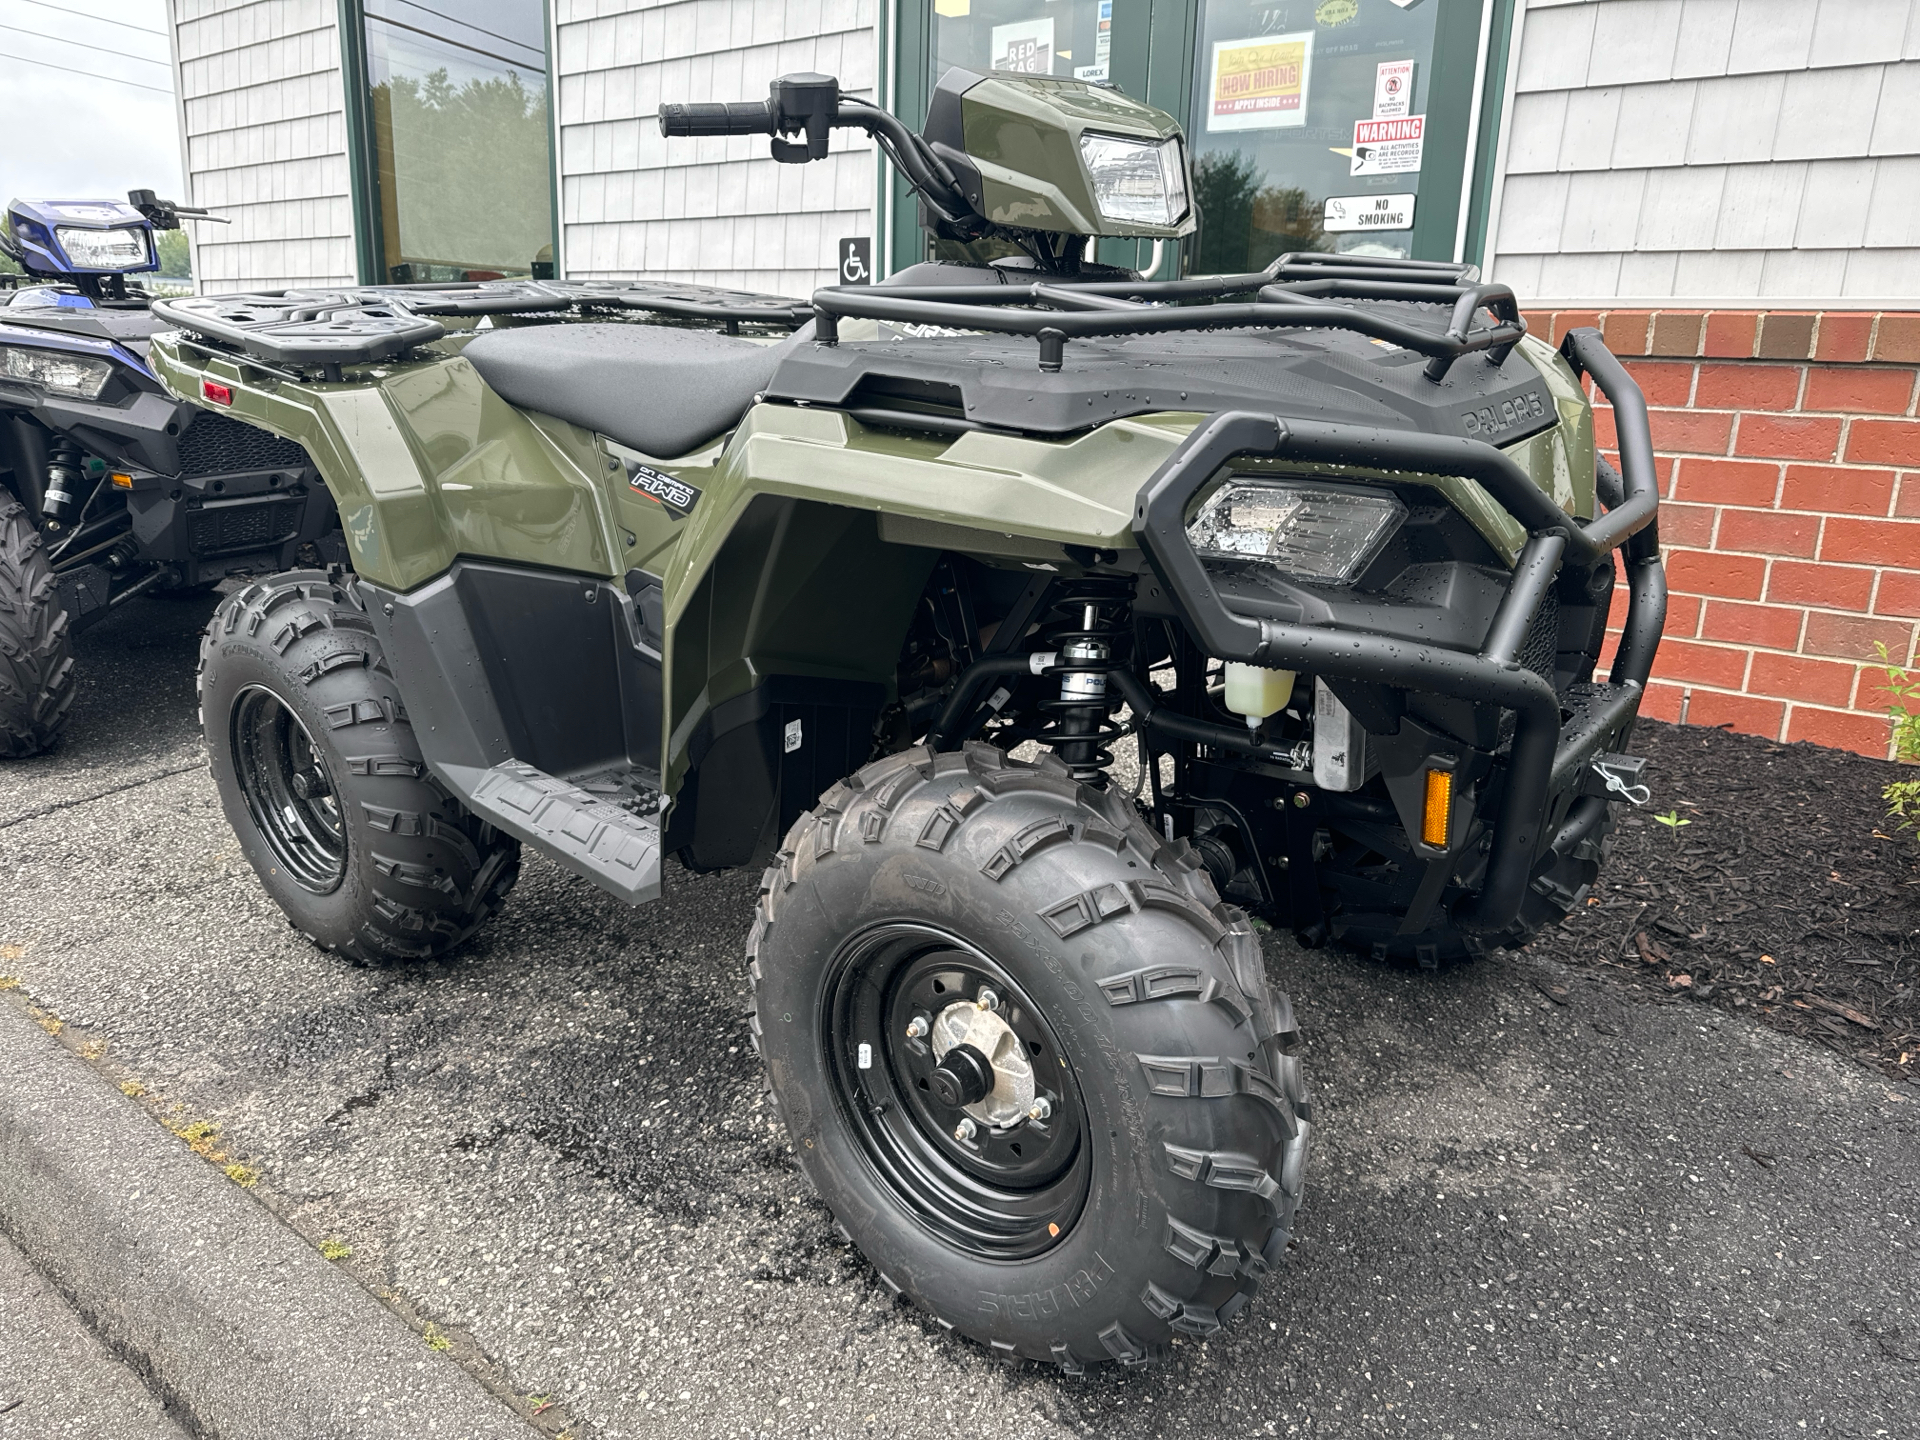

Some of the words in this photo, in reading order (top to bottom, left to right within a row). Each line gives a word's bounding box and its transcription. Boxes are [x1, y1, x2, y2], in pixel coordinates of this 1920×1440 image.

[1009, 42, 1035, 62] RED
[1009, 58, 1035, 72] TAG
[1381, 66, 1410, 76] ATTENTION
[1082, 69, 1104, 77] LOREX
[1223, 73, 1251, 95] NOW
[1253, 65, 1296, 90] HIRING
[1234, 98, 1256, 110] APPLY
[1256, 97, 1281, 108] INSIDE
[1360, 119, 1421, 142] WARNING
[1390, 142, 1419, 150] ACTIVITIES
[1390, 149, 1419, 157] RECORDED
[1375, 199, 1389, 211] NO
[1358, 212, 1404, 226] SMOKING
[1461, 391, 1544, 440] POLARIS
[640, 466, 655, 477] ON
[656, 473, 695, 495] DEMAND
[631, 472, 691, 507] AWD
[978, 1251, 1115, 1320] POLARIS
